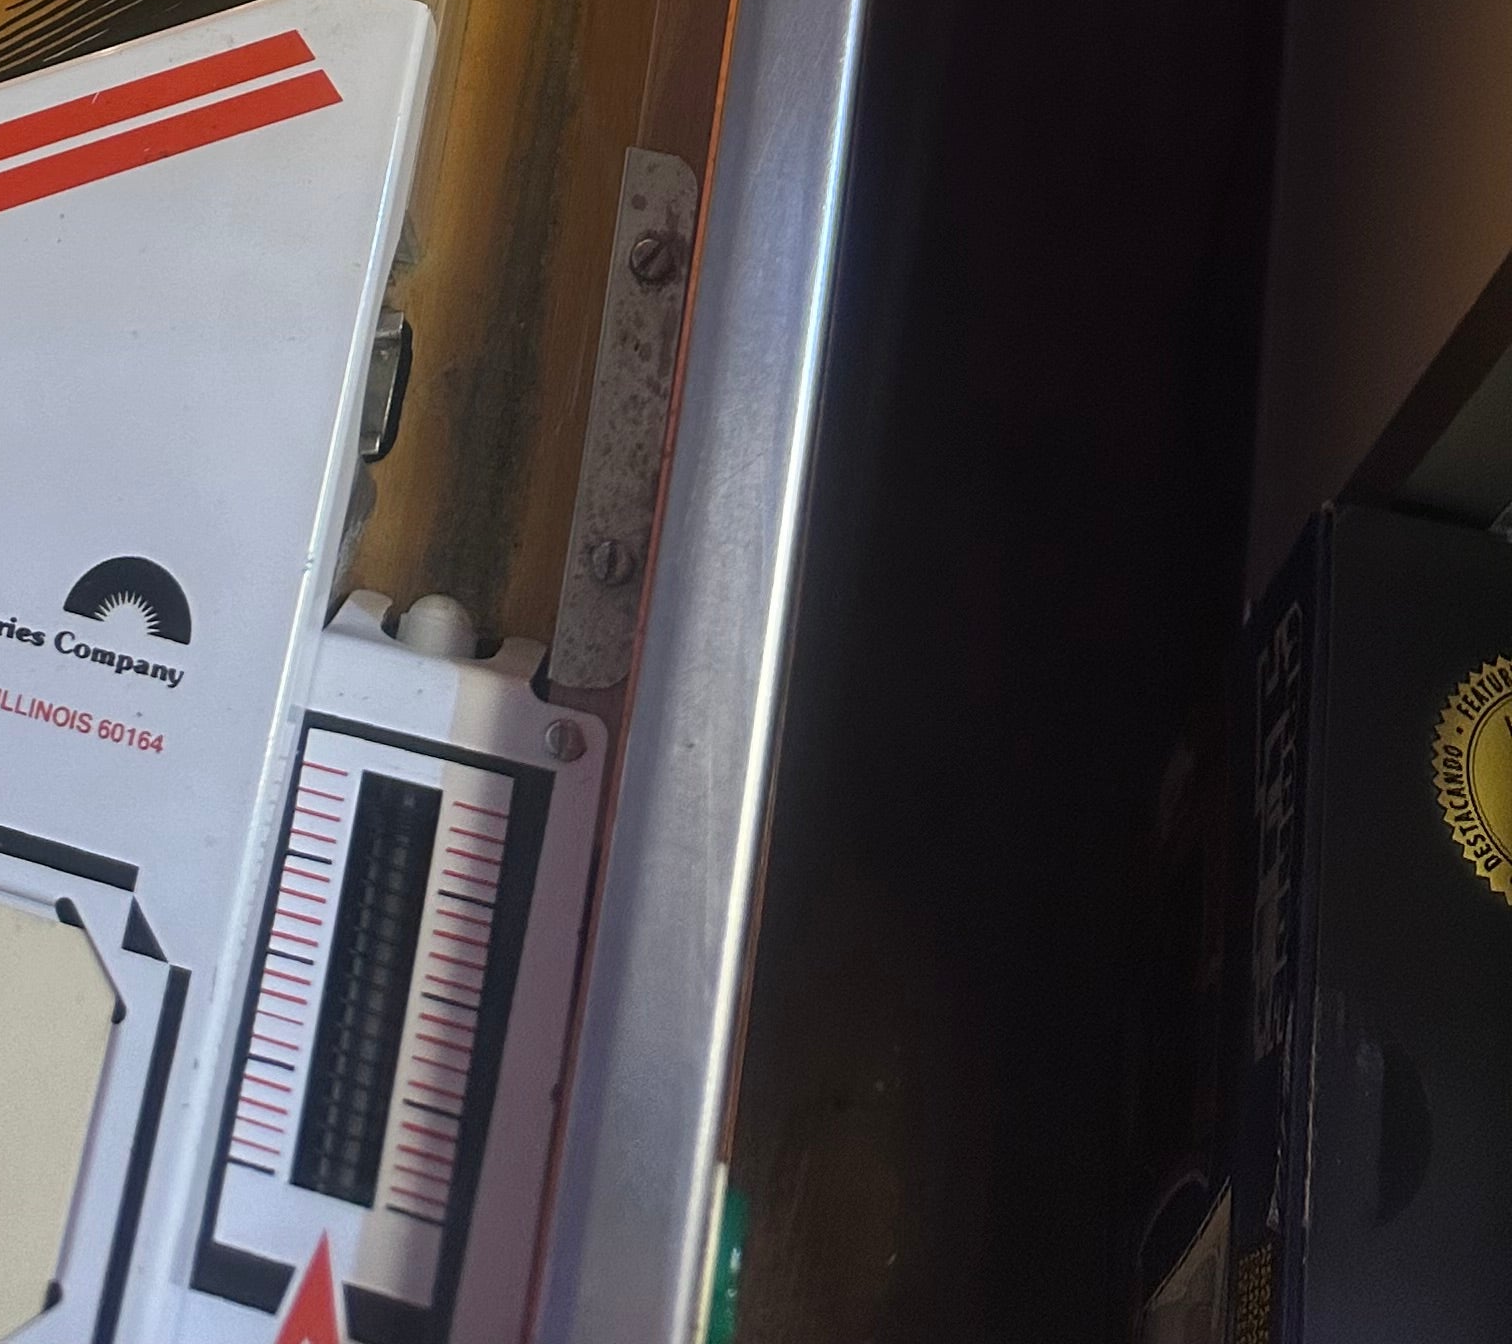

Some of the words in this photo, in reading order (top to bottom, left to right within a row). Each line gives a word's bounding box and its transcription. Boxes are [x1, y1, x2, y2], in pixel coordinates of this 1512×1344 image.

[53, 629, 186, 689] Company
[1455, 665, 1512, 722] FEATUR
[96, 718, 165, 755] 60164
[1442, 743, 1503, 873] DESTACANDO
